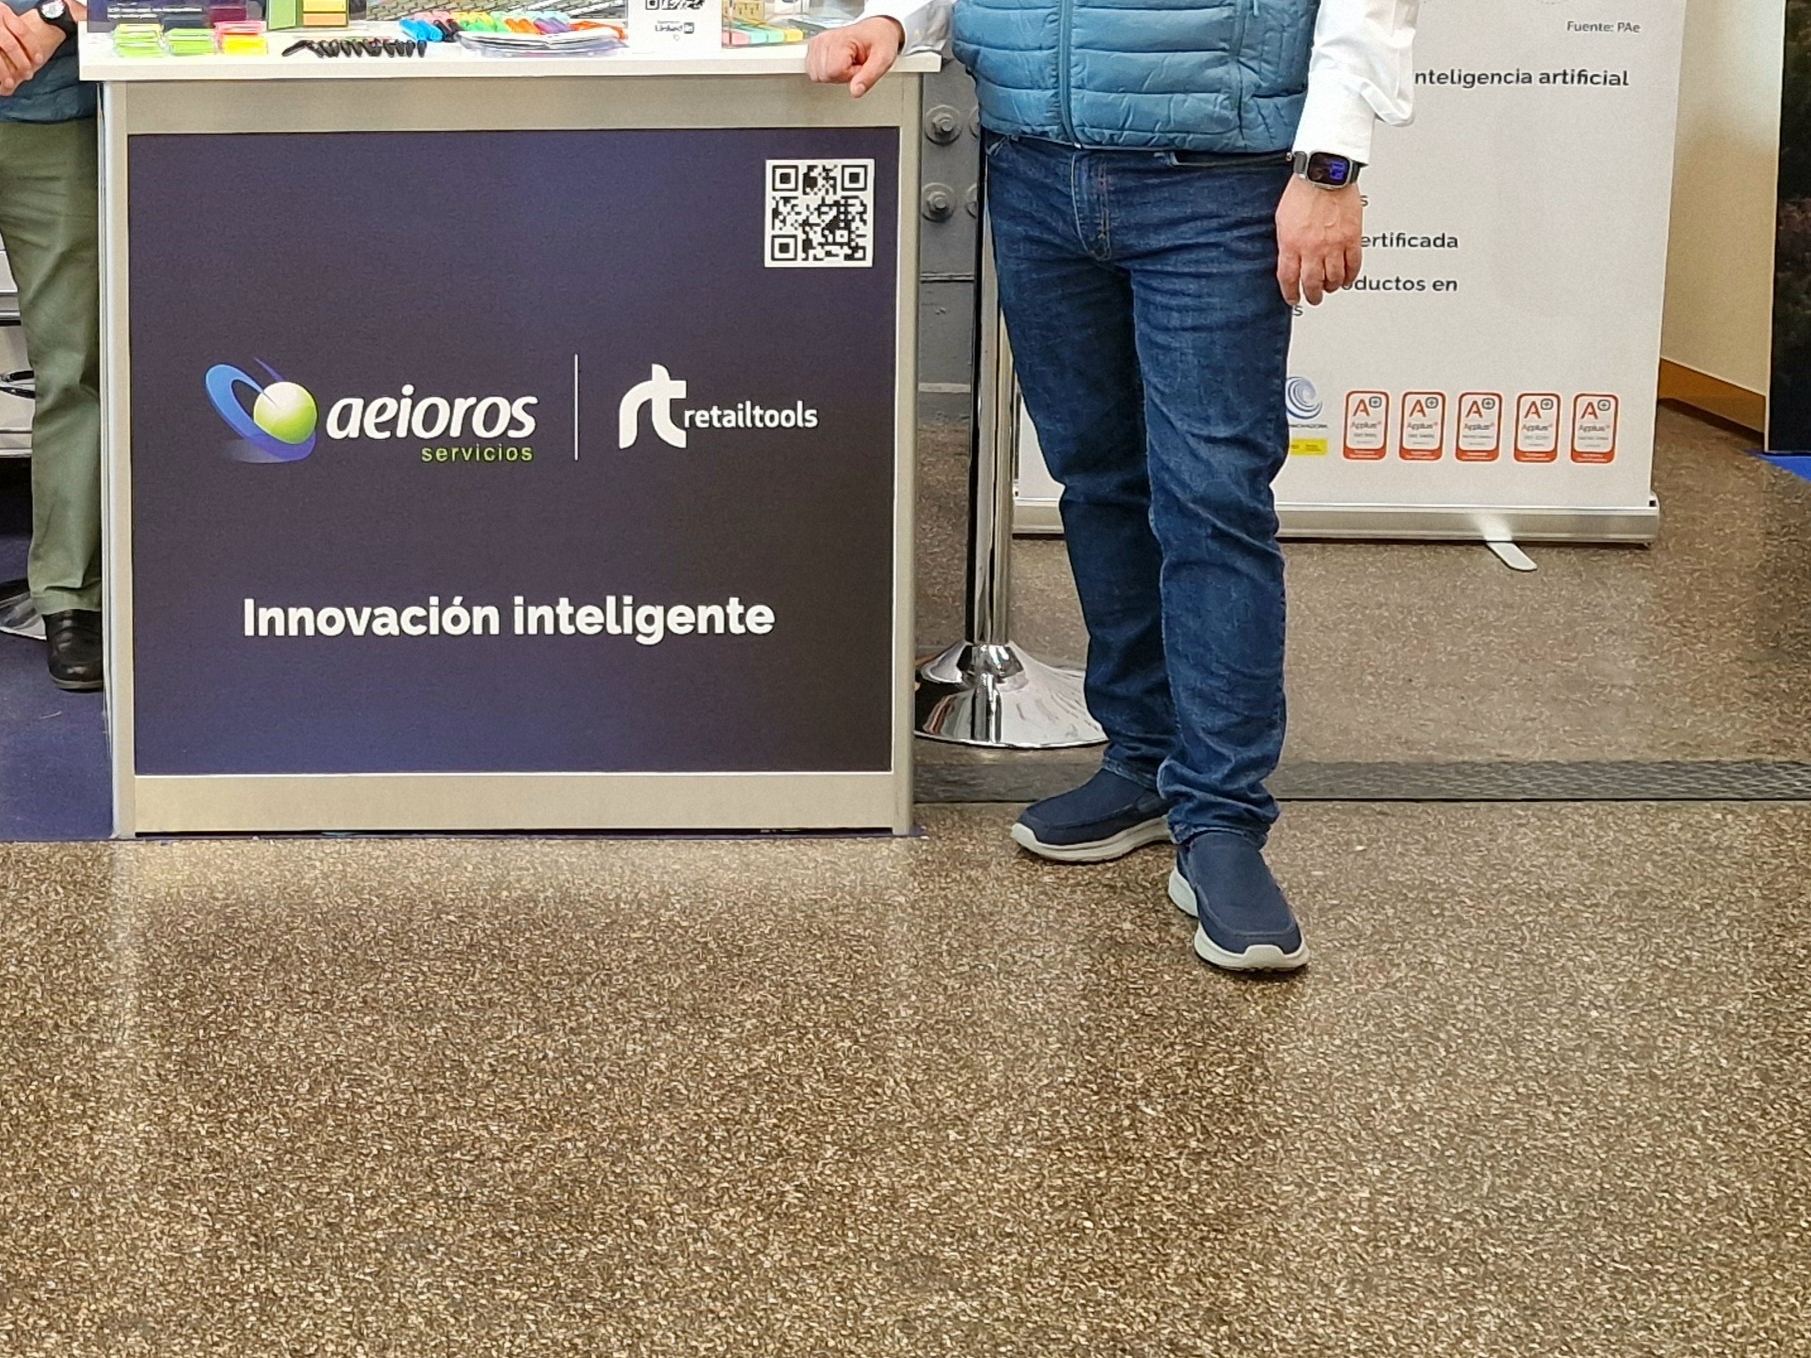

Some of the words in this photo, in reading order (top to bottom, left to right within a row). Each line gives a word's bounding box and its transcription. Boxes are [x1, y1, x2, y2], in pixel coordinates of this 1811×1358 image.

[1567, 20, 1614, 33] Fuente:
[1617, 21, 1641, 33] PAe
[1415, 68, 1533, 89] nteligencia
[1539, 69, 1629, 86] artificial
[1361, 232, 1459, 248] ertificada
[1432, 279, 1458, 291] en
[327, 385, 537, 440] aeioros
[684, 400, 818, 430] retailtools
[421, 444, 533, 463] servicios
[244, 595, 500, 637] Innovación
[514, 595, 775, 644] inteligente
